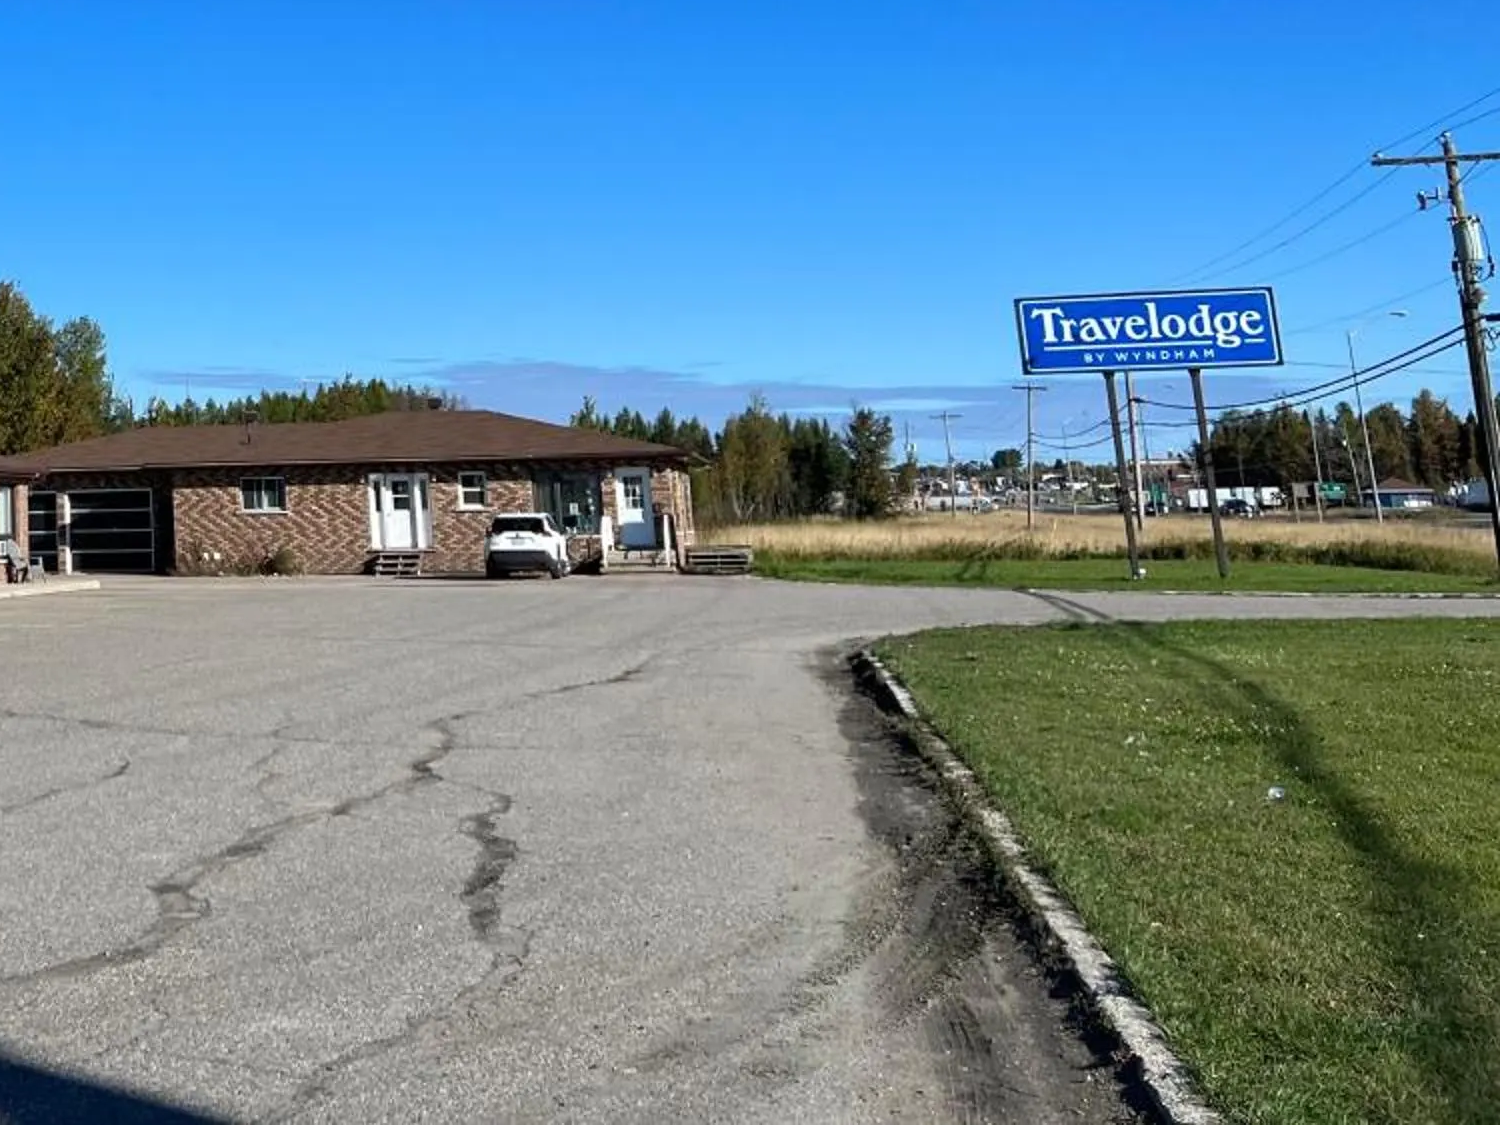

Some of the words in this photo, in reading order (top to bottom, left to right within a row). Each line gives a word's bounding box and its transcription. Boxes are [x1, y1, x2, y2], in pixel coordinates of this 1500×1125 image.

[1030, 302, 1265, 348] Travelodge
[1083, 352, 1105, 364] BY
[1114, 348, 1216, 363] WYNDHAM
